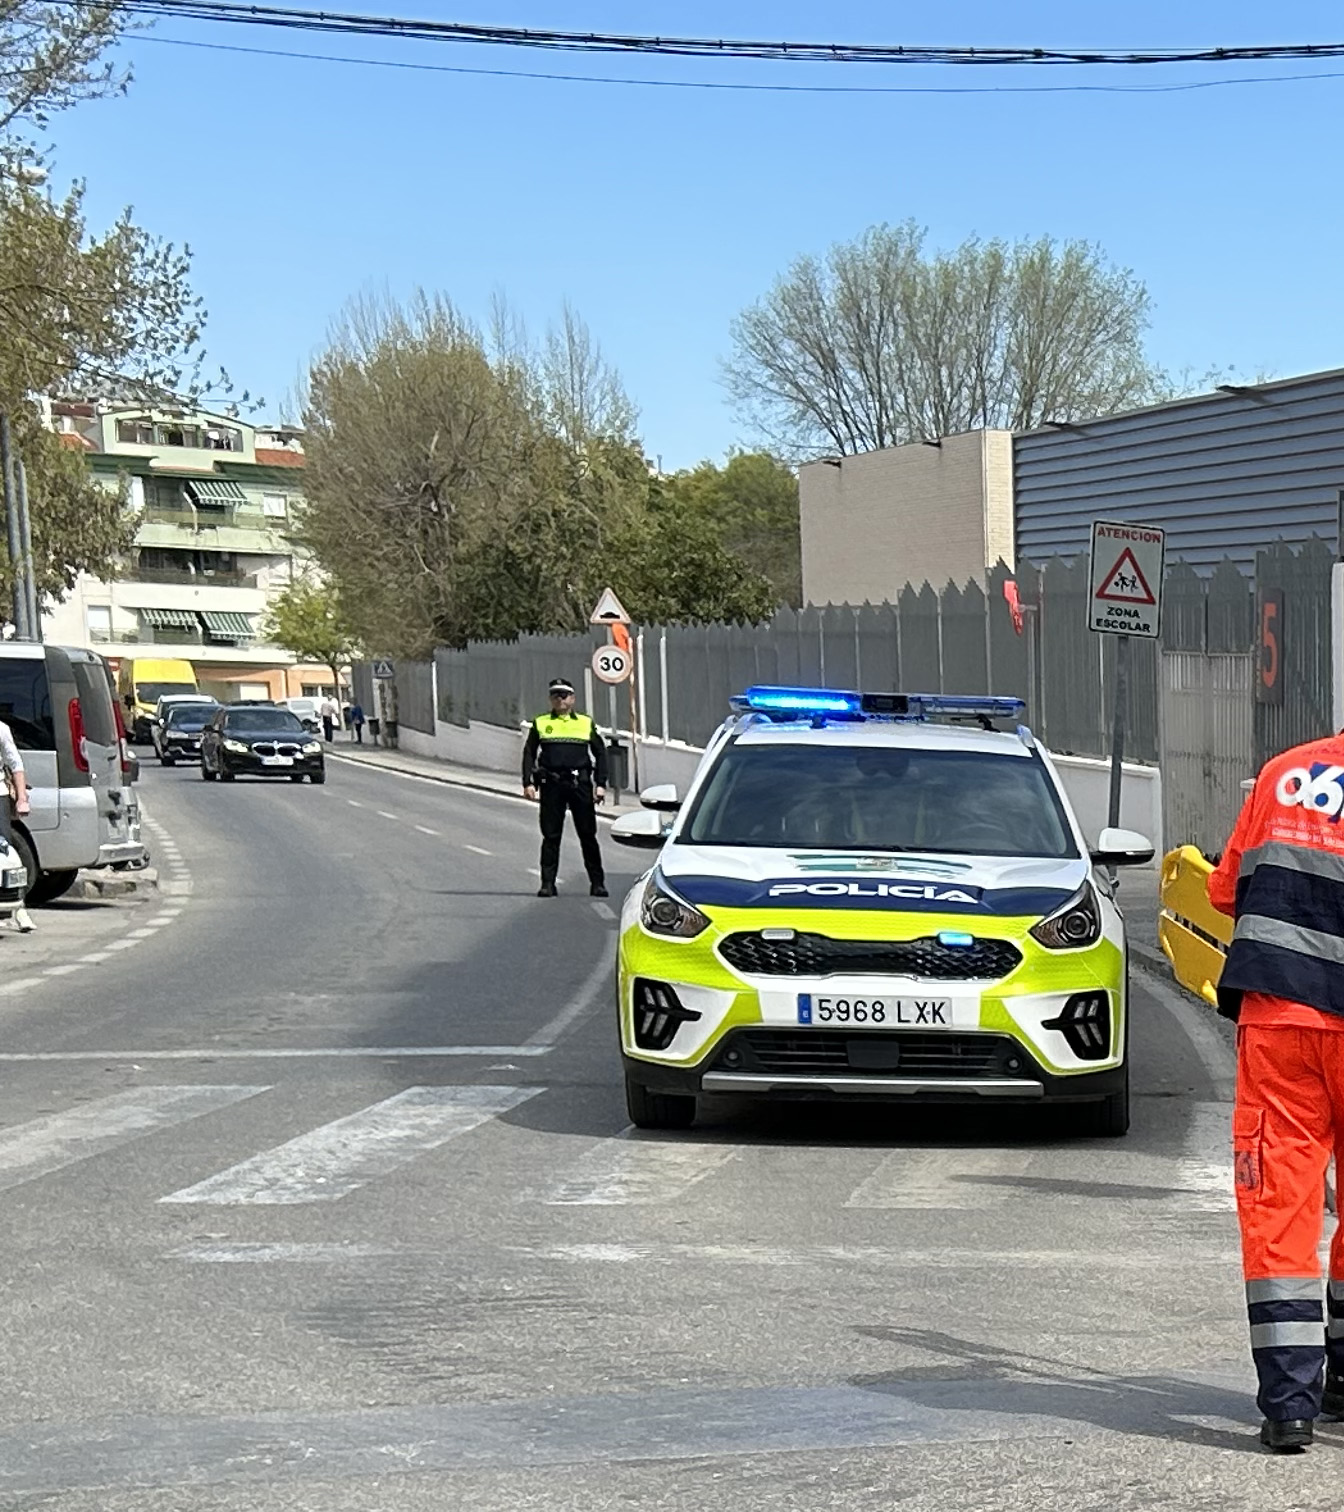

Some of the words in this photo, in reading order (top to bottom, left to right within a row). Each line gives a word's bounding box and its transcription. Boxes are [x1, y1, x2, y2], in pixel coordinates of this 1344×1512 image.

[1097, 526, 1161, 543] ATENCION
[1107, 606, 1140, 619] ZONA
[1096, 618, 1151, 633] ESCOLAR
[600, 656, 624, 671] 30
[818, 999, 886, 1022] 5968
[897, 1000, 946, 1024] LXK
